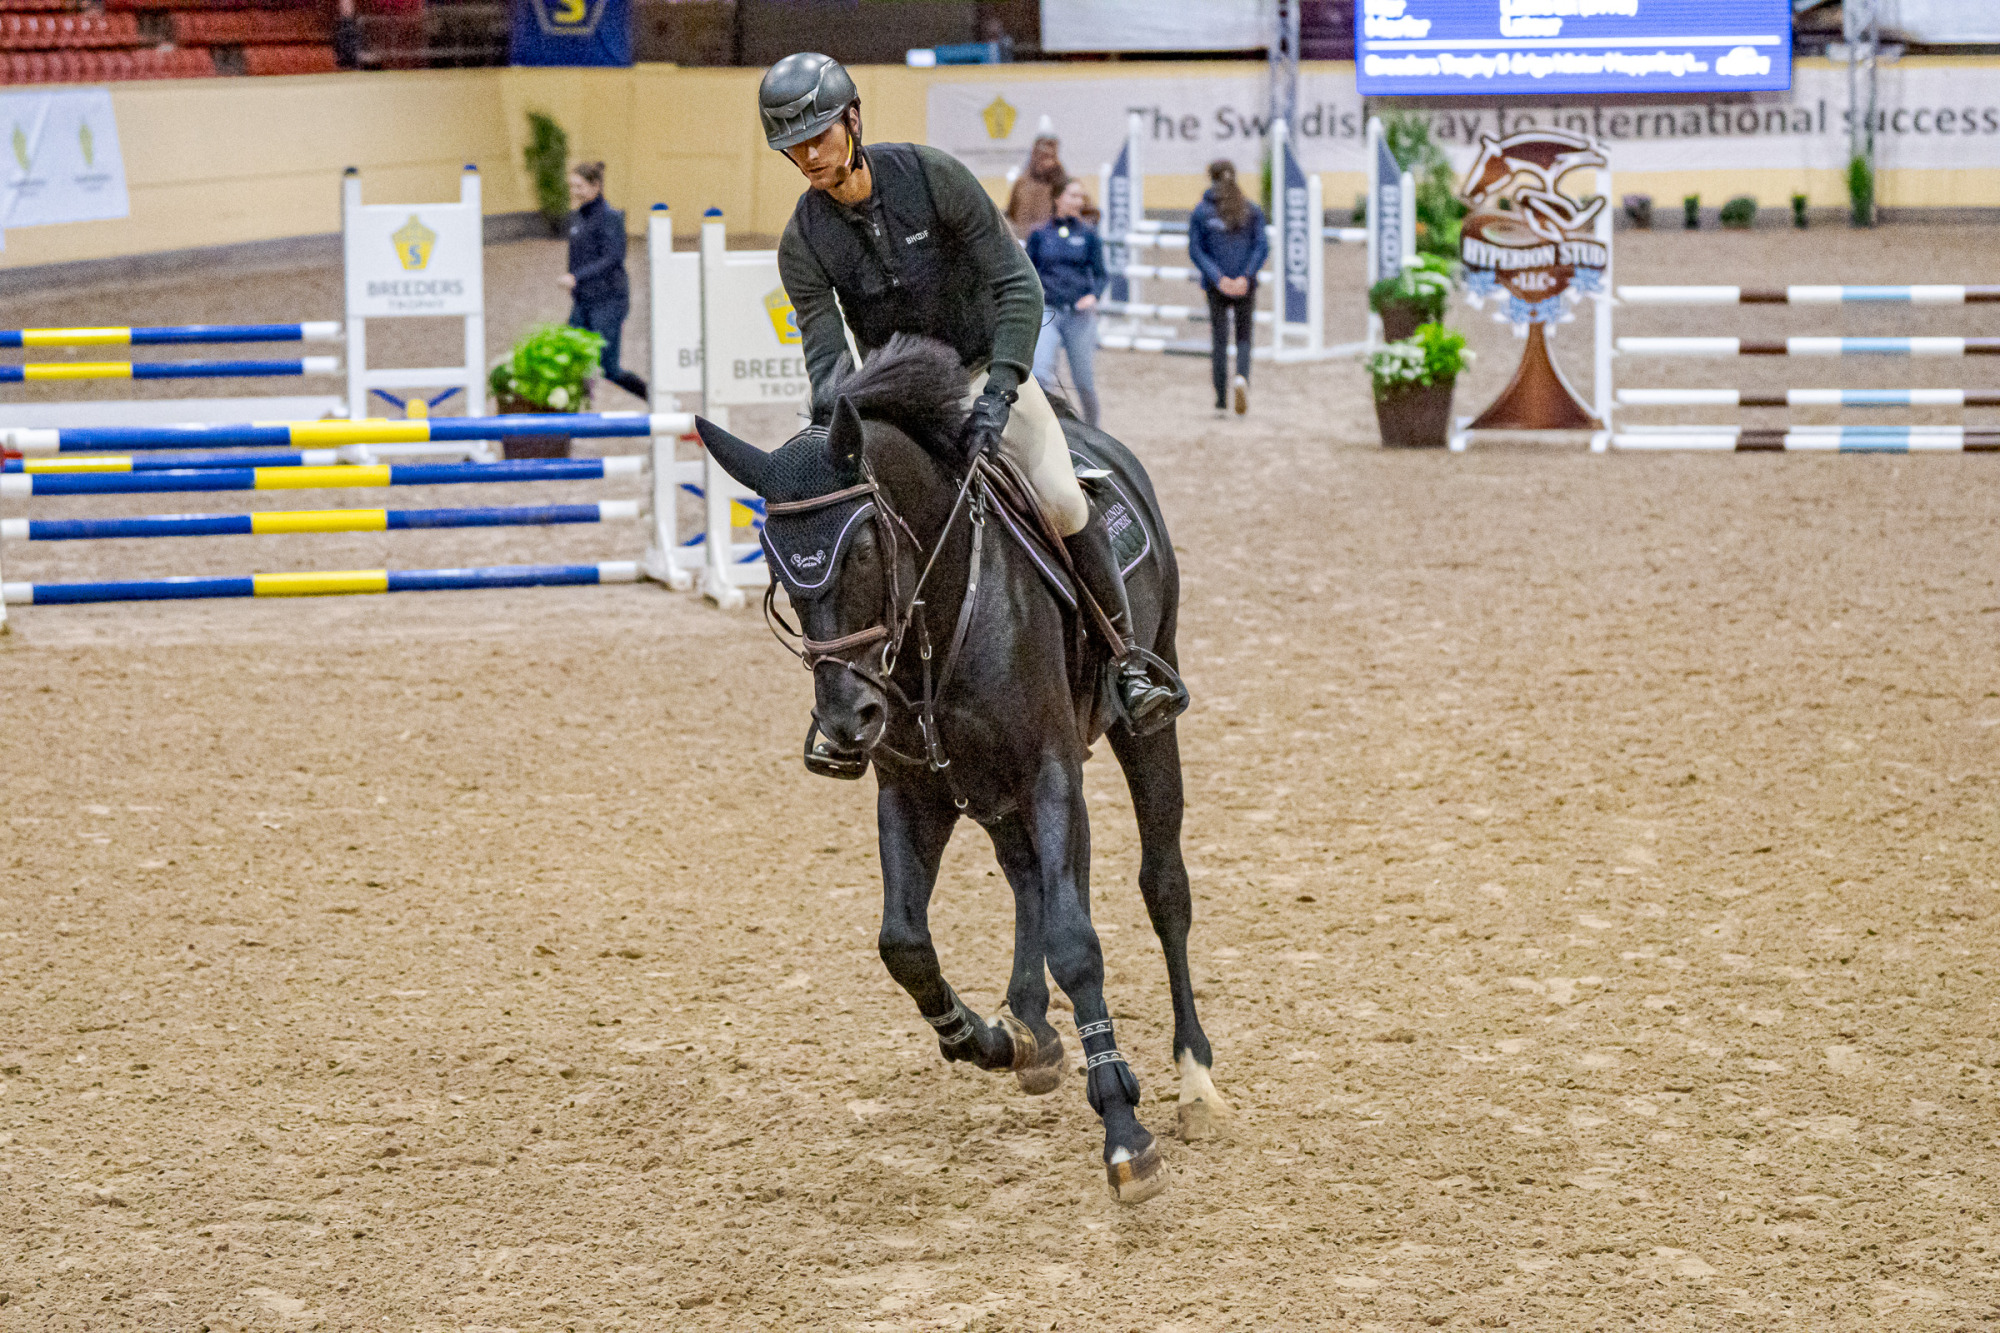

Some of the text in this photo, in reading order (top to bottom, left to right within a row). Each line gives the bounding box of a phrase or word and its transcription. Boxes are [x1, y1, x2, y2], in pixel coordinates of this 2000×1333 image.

[1215, 104, 1370, 139] Swdis
[1553, 100, 1826, 138] international
[1559, 240, 1607, 268] STUD
[366, 280, 464, 297] BREEDERS
[733, 357, 807, 379] BREED
[759, 382, 809, 397] TROP
[1102, 501, 1127, 525] LUNDA
[1107, 513, 1133, 541] TUTERI
